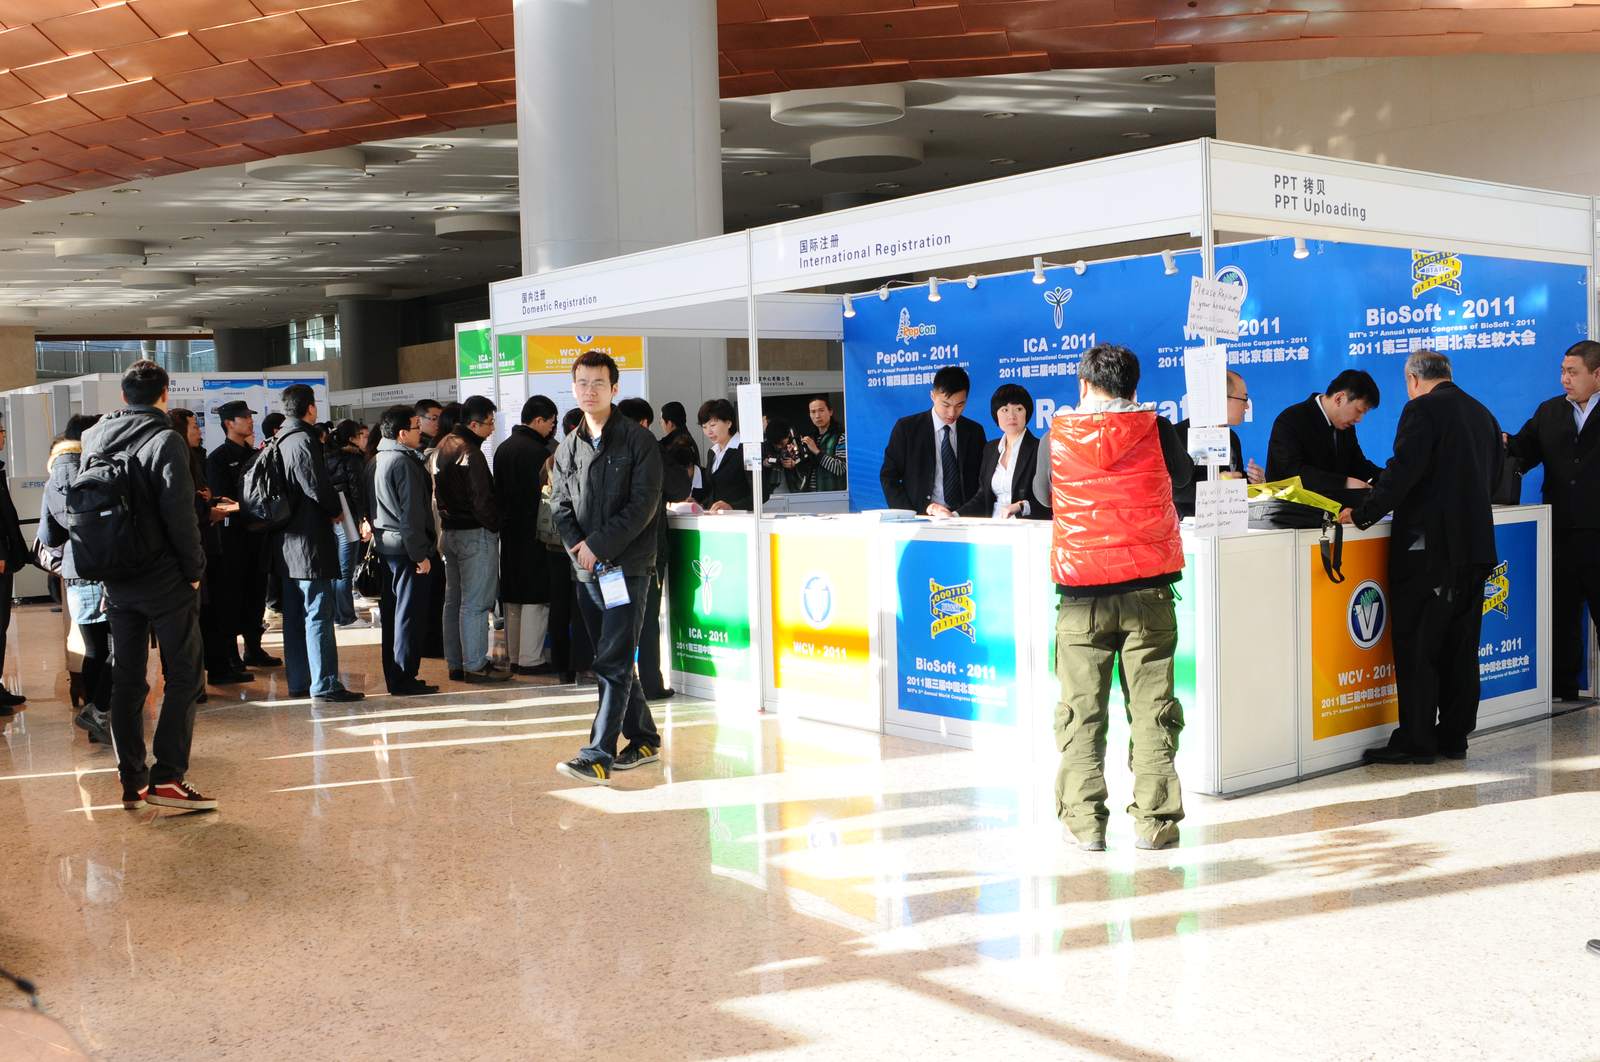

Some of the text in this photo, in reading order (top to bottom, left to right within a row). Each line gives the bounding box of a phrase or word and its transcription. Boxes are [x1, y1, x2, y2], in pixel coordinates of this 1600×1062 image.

[1274, 174, 1325, 195] PPT 拷贝
[1275, 194, 1366, 222] PPT Uploading
[800, 233, 839, 254] 国际注册
[800, 234, 951, 269] International Registration
[522, 289, 546, 304] 国内注册
[522, 295, 597, 315] Domestic Registration
[1366, 303, 1442, 326] BioSoft
[1462, 296, 1515, 319] 2011
[903, 323, 937, 339] PepCon
[1238, 317, 1280, 337] 2011
[1349, 331, 1368, 339] BIT's
[1380, 329, 1405, 337] Annual
[1431, 324, 1468, 333] Congress
[1480, 320, 1509, 329] BioSoft
[1023, 337, 1049, 353] ICA
[1061, 332, 1096, 350] 2011
[1253, 339, 1284, 347] Congress
[1290, 336, 1308, 344] 2011
[560, 348, 581, 356] WCV
[876, 349, 919, 366] PepCon
[929, 344, 959, 360] 2011
[688, 627, 702, 640] ICA
[709, 630, 728, 643] 2011
[1501, 637, 1522, 653] 2011
[793, 640, 814, 656] WCV
[823, 645, 847, 659] 2011
[916, 657, 956, 675] BioSoft
[967, 664, 996, 680] 2011
[1338, 669, 1364, 686] WCV
[1373, 664, 1395, 679] 201
